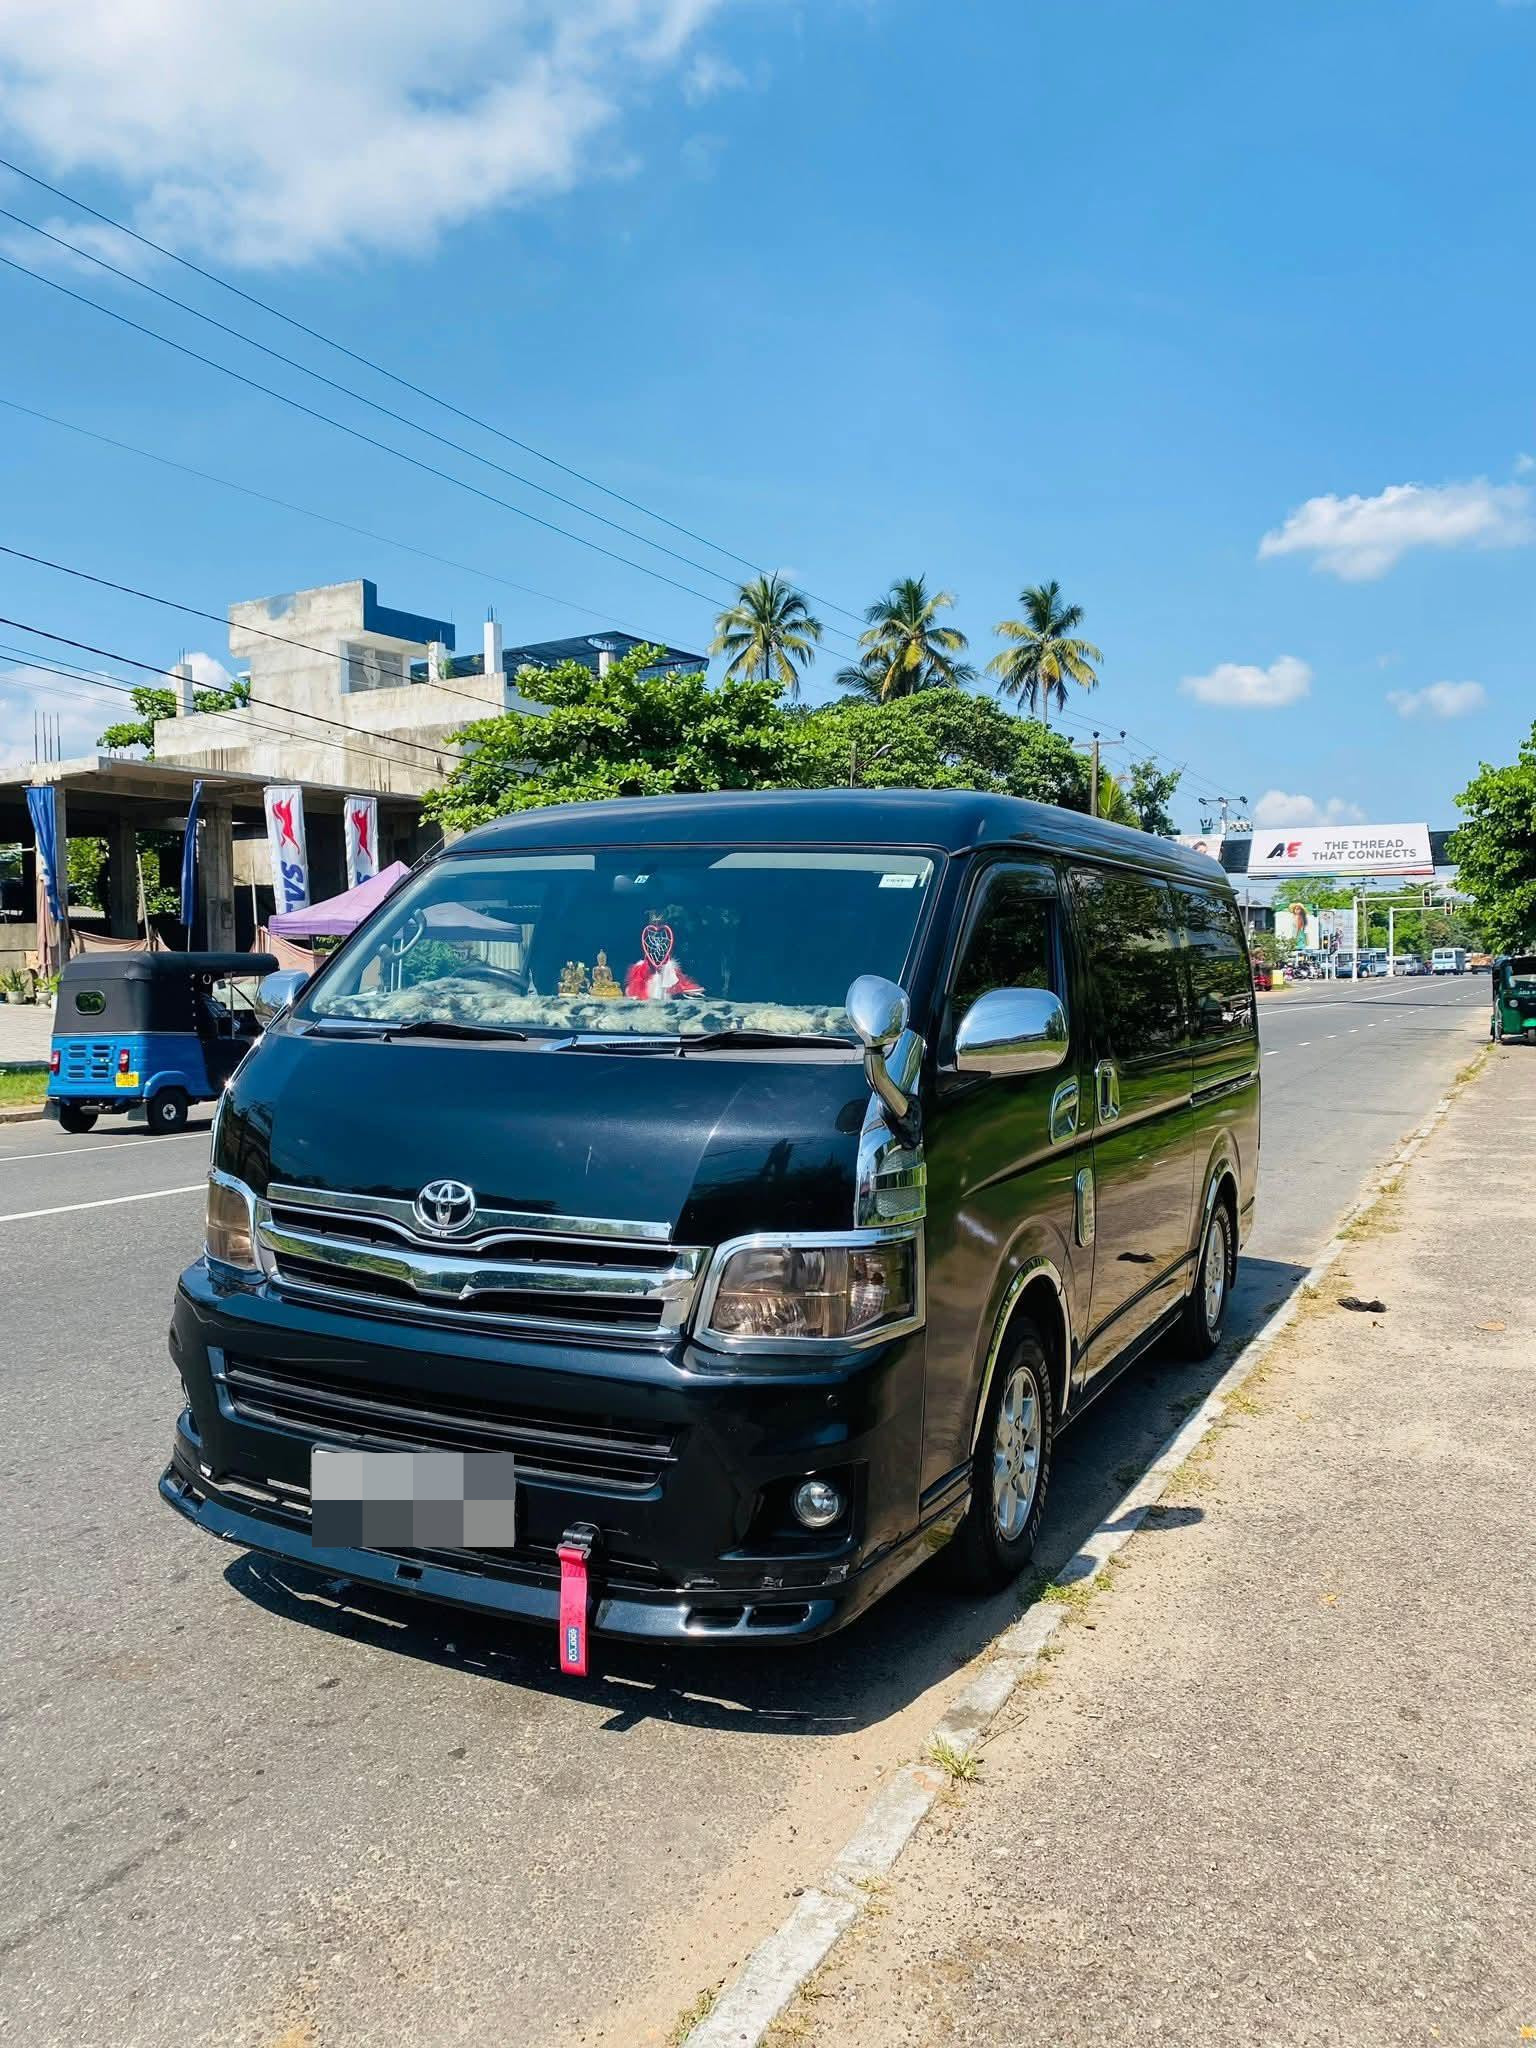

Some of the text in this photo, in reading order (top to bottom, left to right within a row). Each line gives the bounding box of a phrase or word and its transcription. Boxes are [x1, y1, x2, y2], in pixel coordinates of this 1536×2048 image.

[1325, 839, 1404, 850] THE THREAD
[1312, 848, 1417, 861] THAT CONNECTS
